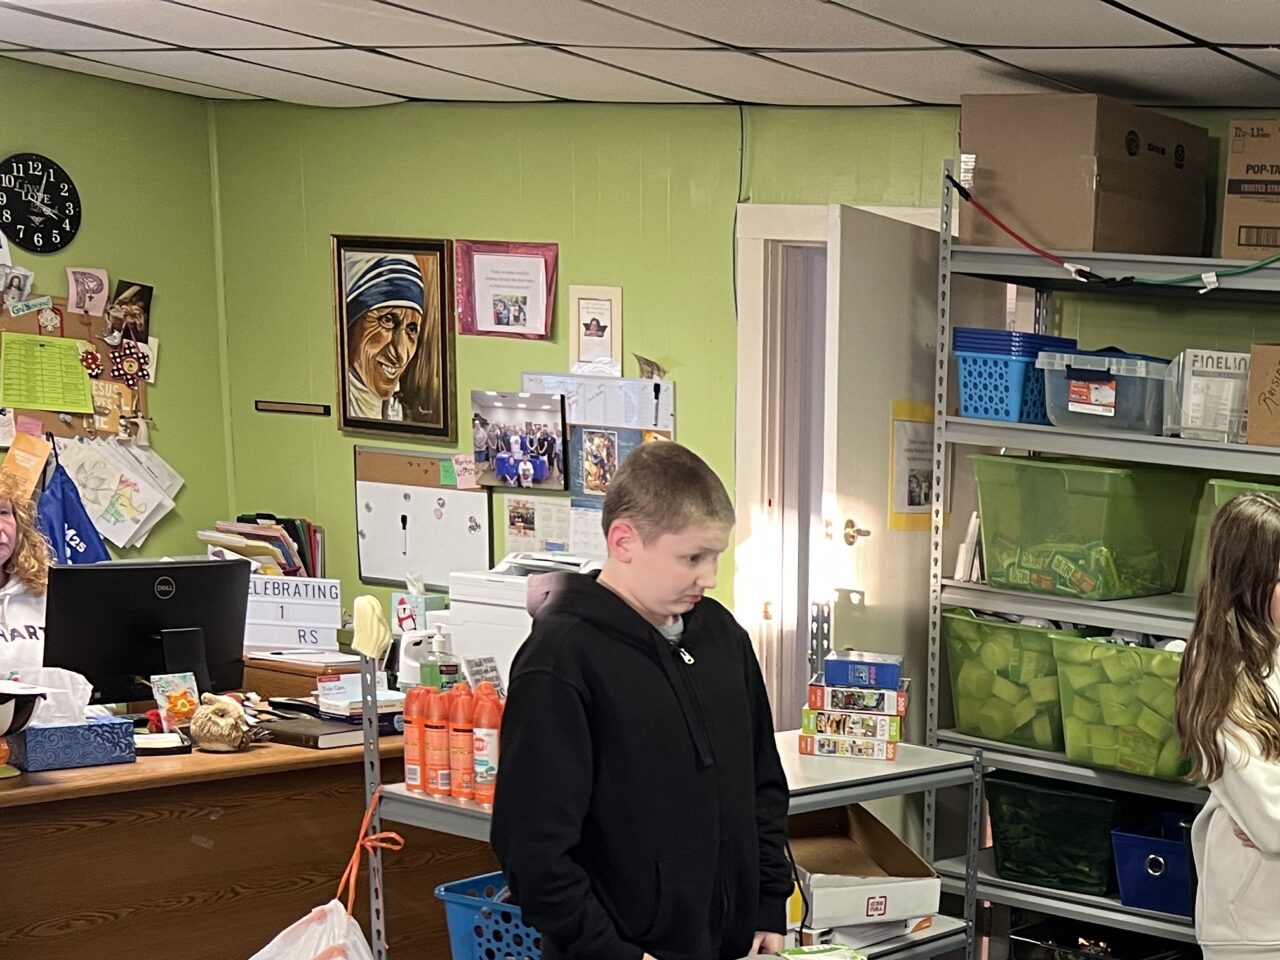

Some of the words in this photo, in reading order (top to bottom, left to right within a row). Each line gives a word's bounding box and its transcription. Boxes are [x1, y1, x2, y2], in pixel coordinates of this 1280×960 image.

[12, 162, 25, 177] 11
[28, 161, 42, 175] 12
[48, 168, 55, 182] 1
[0, 173, 15, 188] 10
[60, 183, 69, 196] 2
[0, 192, 7, 205] 9
[2, 209, 12, 222] 8
[65, 202, 74, 215] 3
[16, 225, 25, 238] 7
[62, 218, 71, 231] 4
[33, 232, 43, 246] 6
[52, 229, 60, 243] 5
[279, 604, 284, 619] 1
[297, 628, 319, 645] RS
